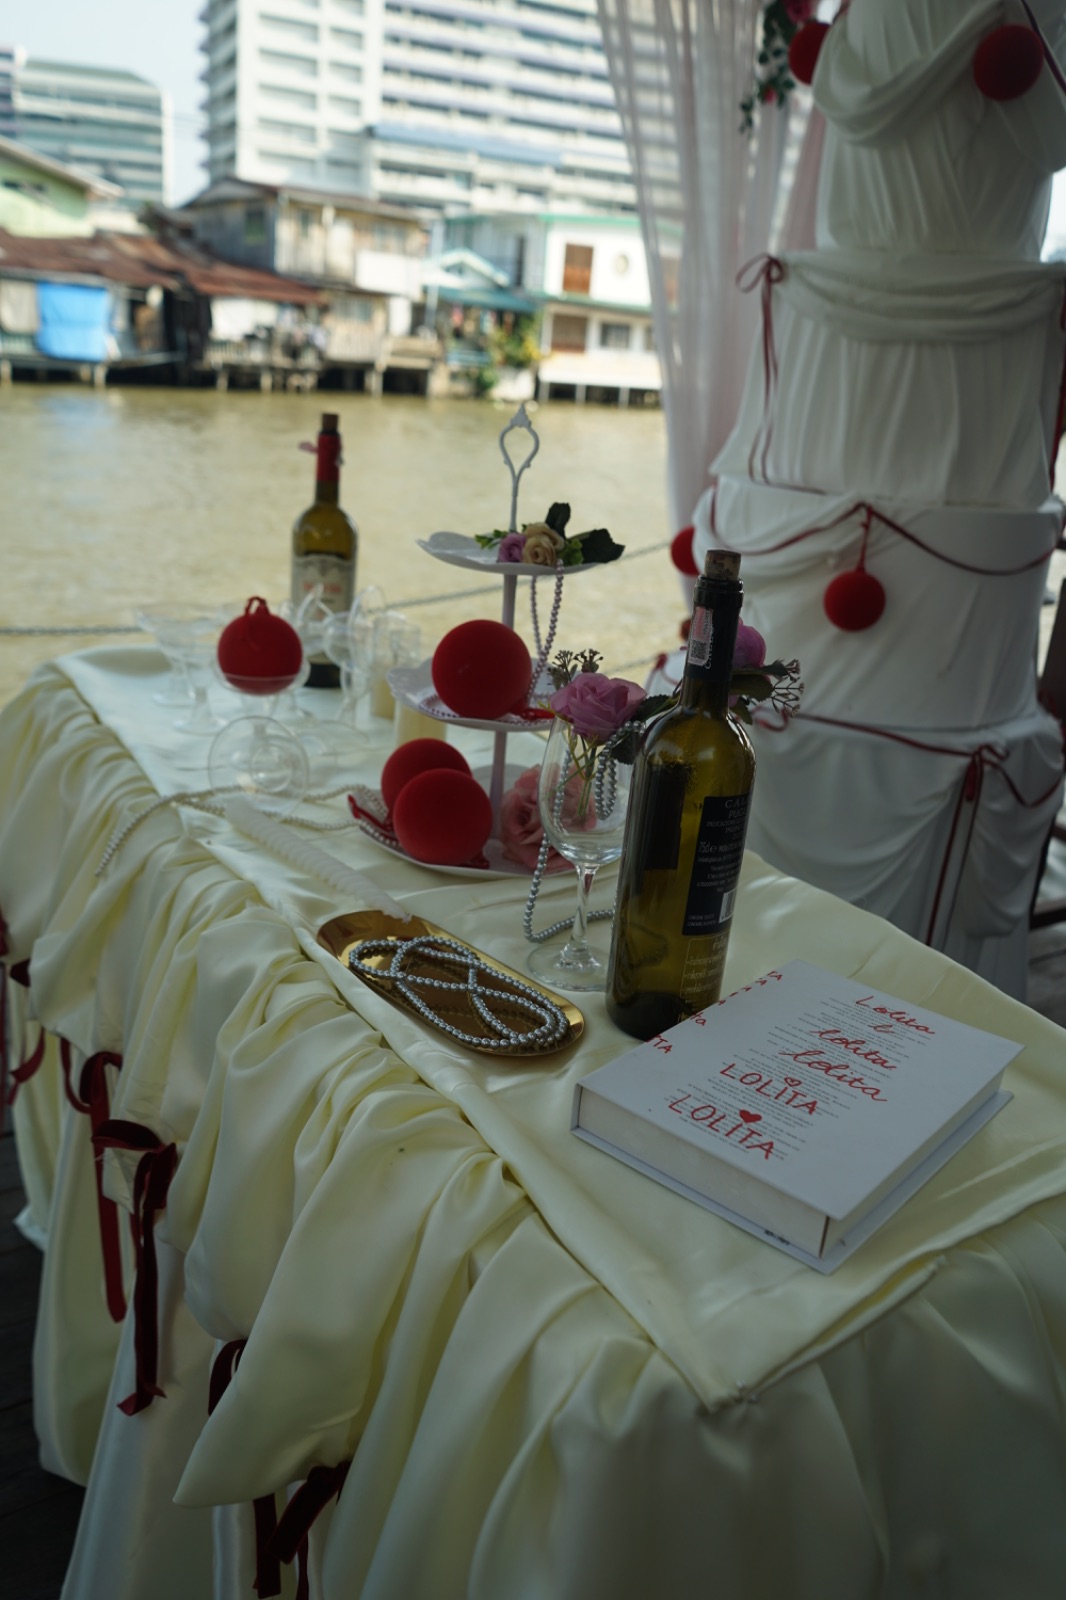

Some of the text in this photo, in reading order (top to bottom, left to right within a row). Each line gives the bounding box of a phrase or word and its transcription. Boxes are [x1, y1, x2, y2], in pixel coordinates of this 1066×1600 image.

[855, 995, 936, 1035] Lolita
[814, 1028, 897, 1070] lolita
[720, 1062, 818, 1116] LOLITA
[778, 1050, 888, 1102] lolita
[668, 1094, 775, 1161] LOLITA
